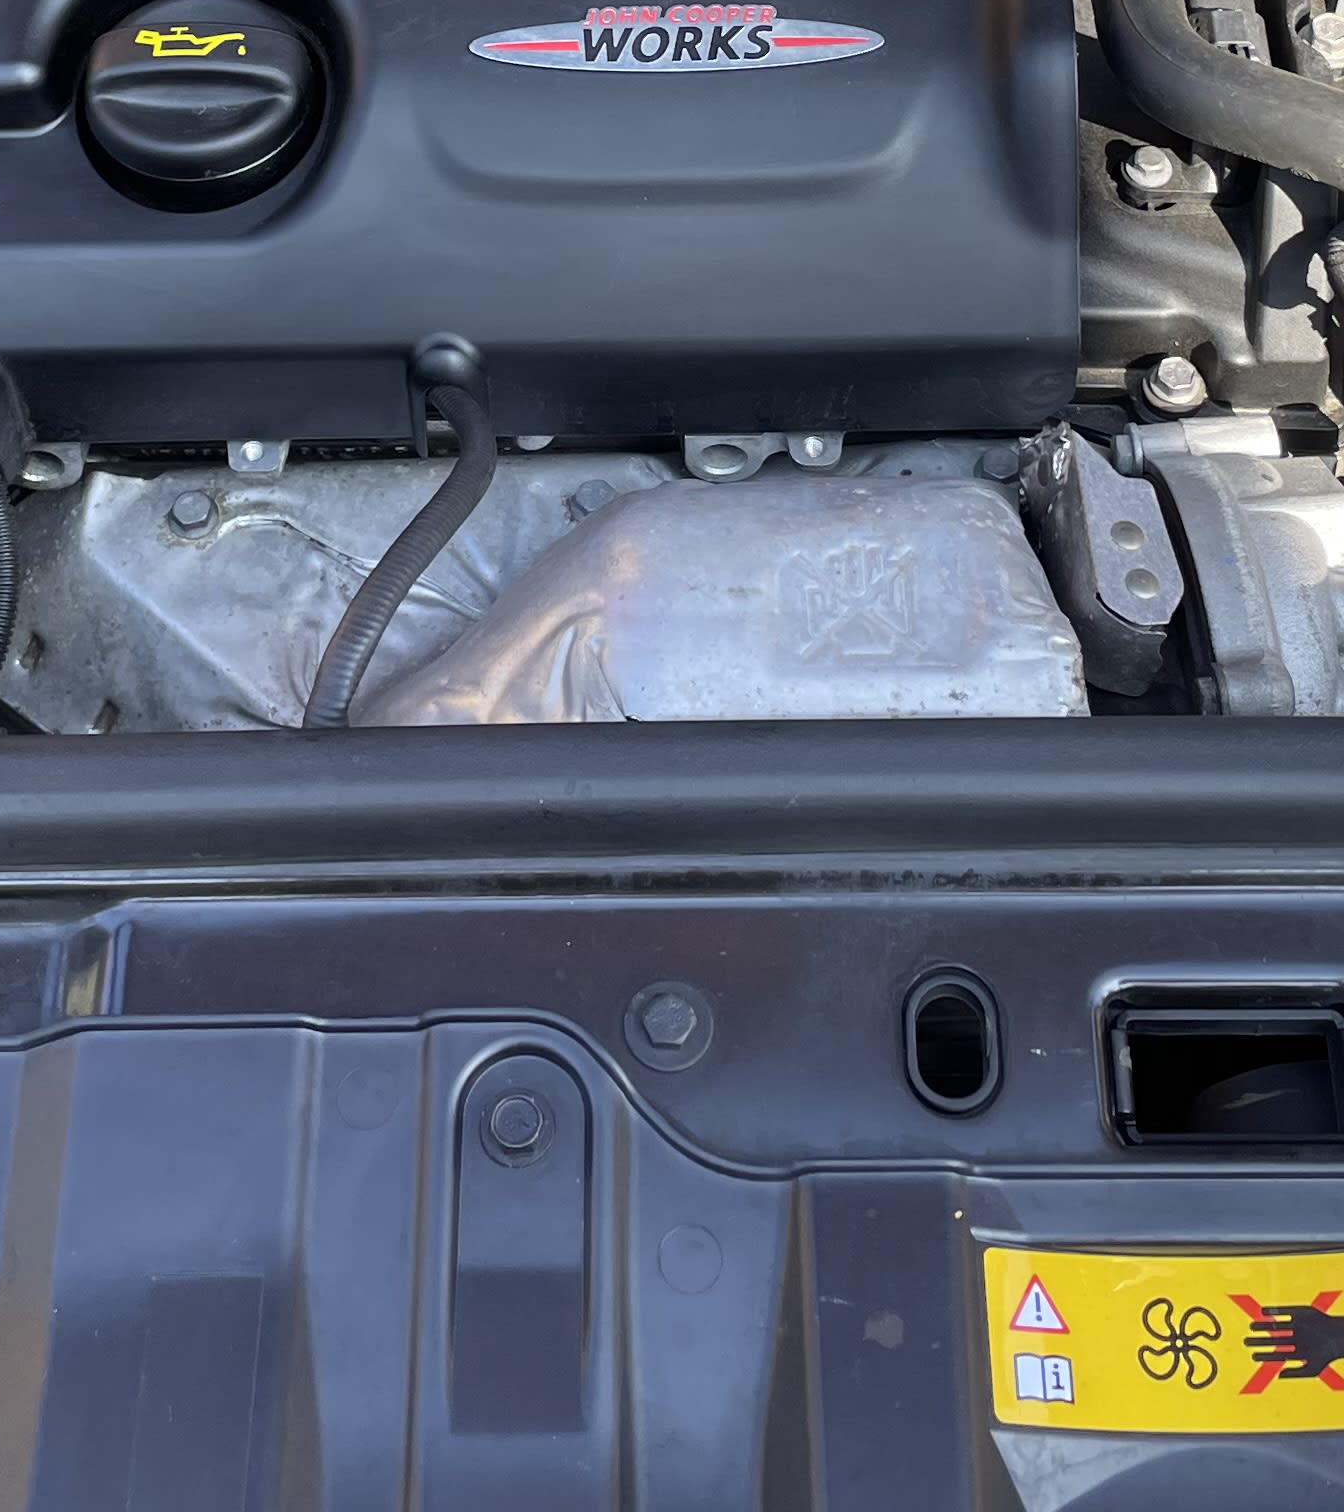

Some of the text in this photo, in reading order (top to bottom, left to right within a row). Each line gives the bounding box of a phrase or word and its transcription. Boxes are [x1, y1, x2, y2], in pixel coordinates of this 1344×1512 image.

[583, 5, 775, 26] JOHN COOPER
[580, 24, 773, 62] WORKS
